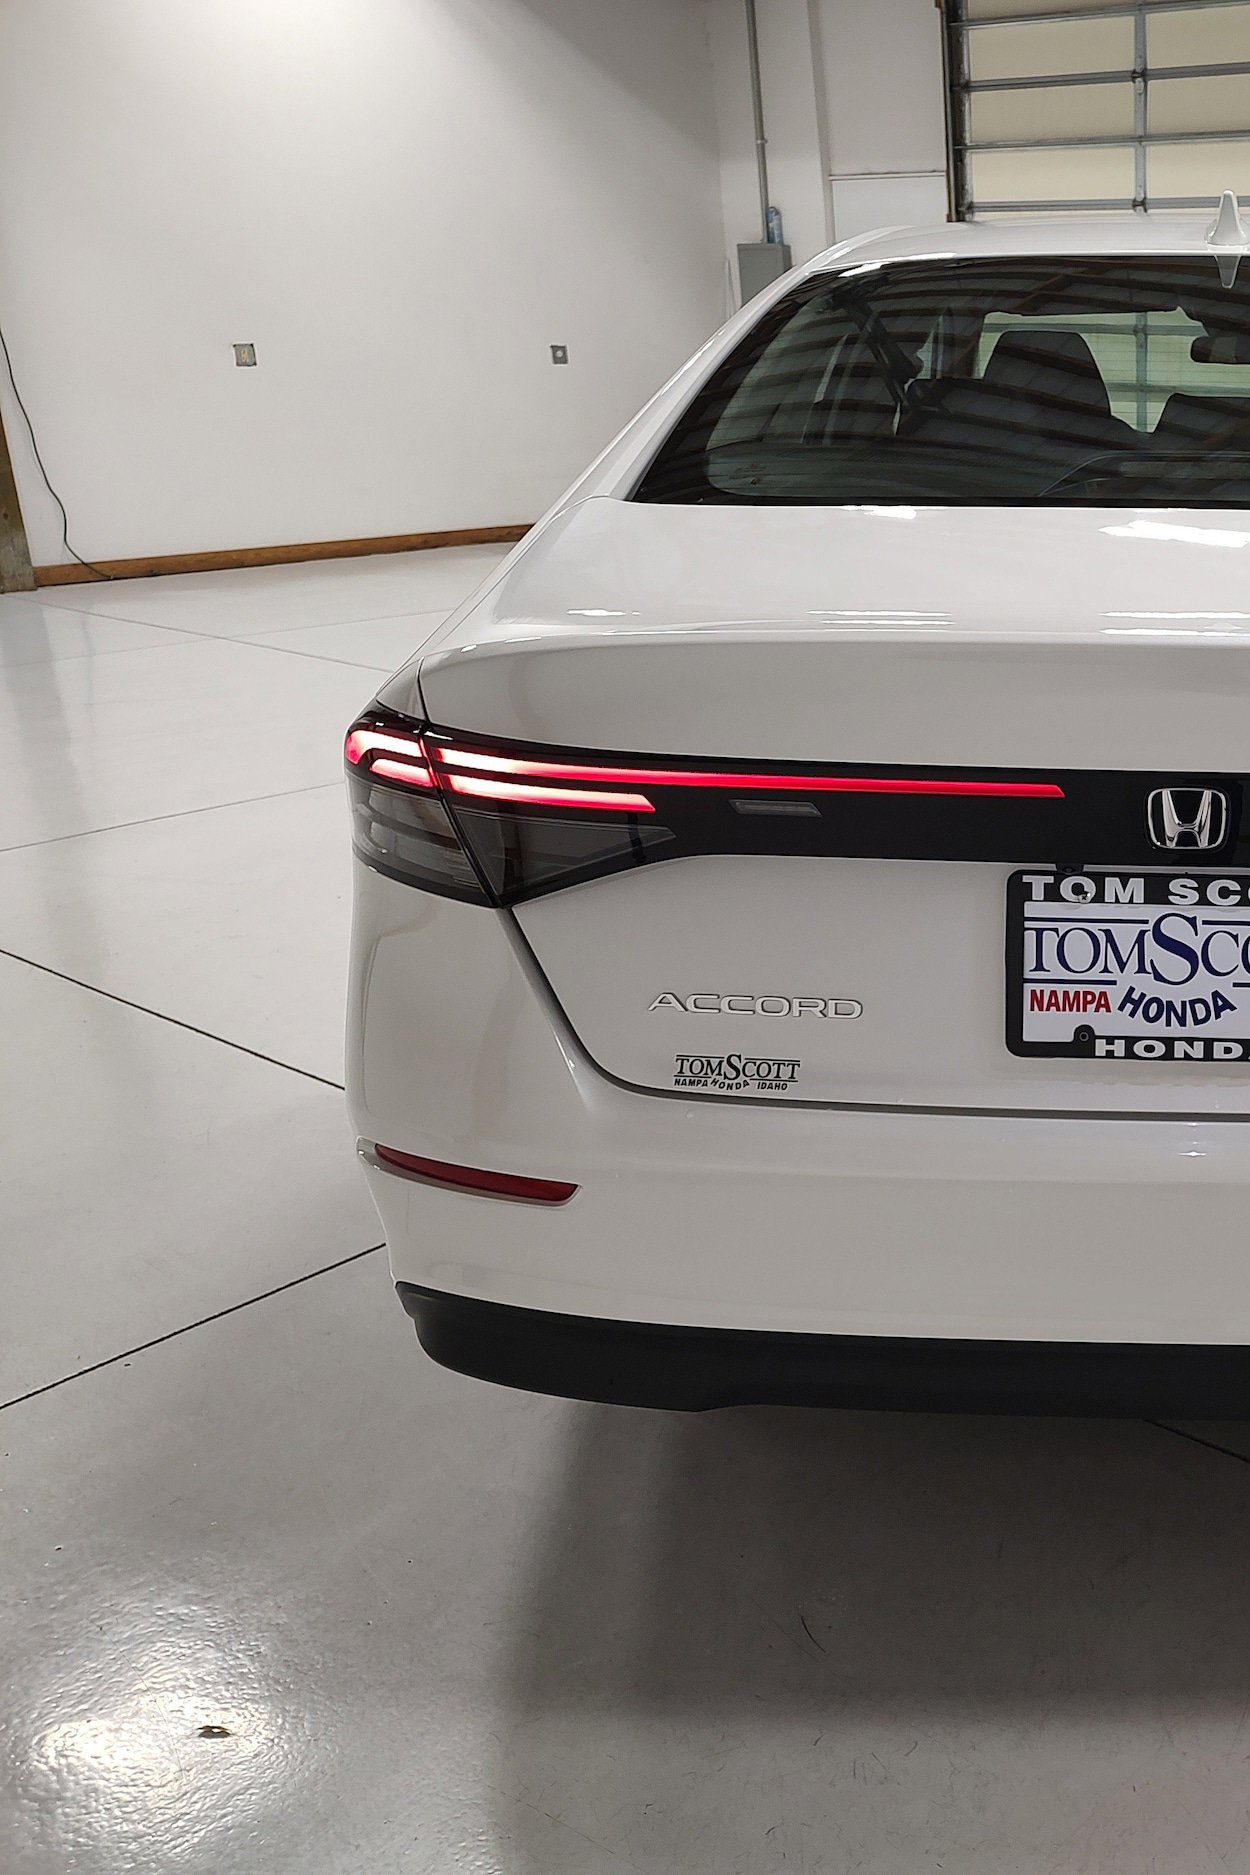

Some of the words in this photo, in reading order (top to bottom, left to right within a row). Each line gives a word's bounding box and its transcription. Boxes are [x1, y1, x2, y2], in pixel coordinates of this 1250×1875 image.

[1022, 875, 1145, 904] TOM
[648, 992, 863, 1019] ACCORD
[1029, 989, 1112, 1013] NAMPA
[1117, 985, 1237, 1028] HONDA
[674, 1078, 708, 1087] NAMPA
[710, 1078, 750, 1091] HONDA
[757, 1082, 788, 1090] IDAHO
